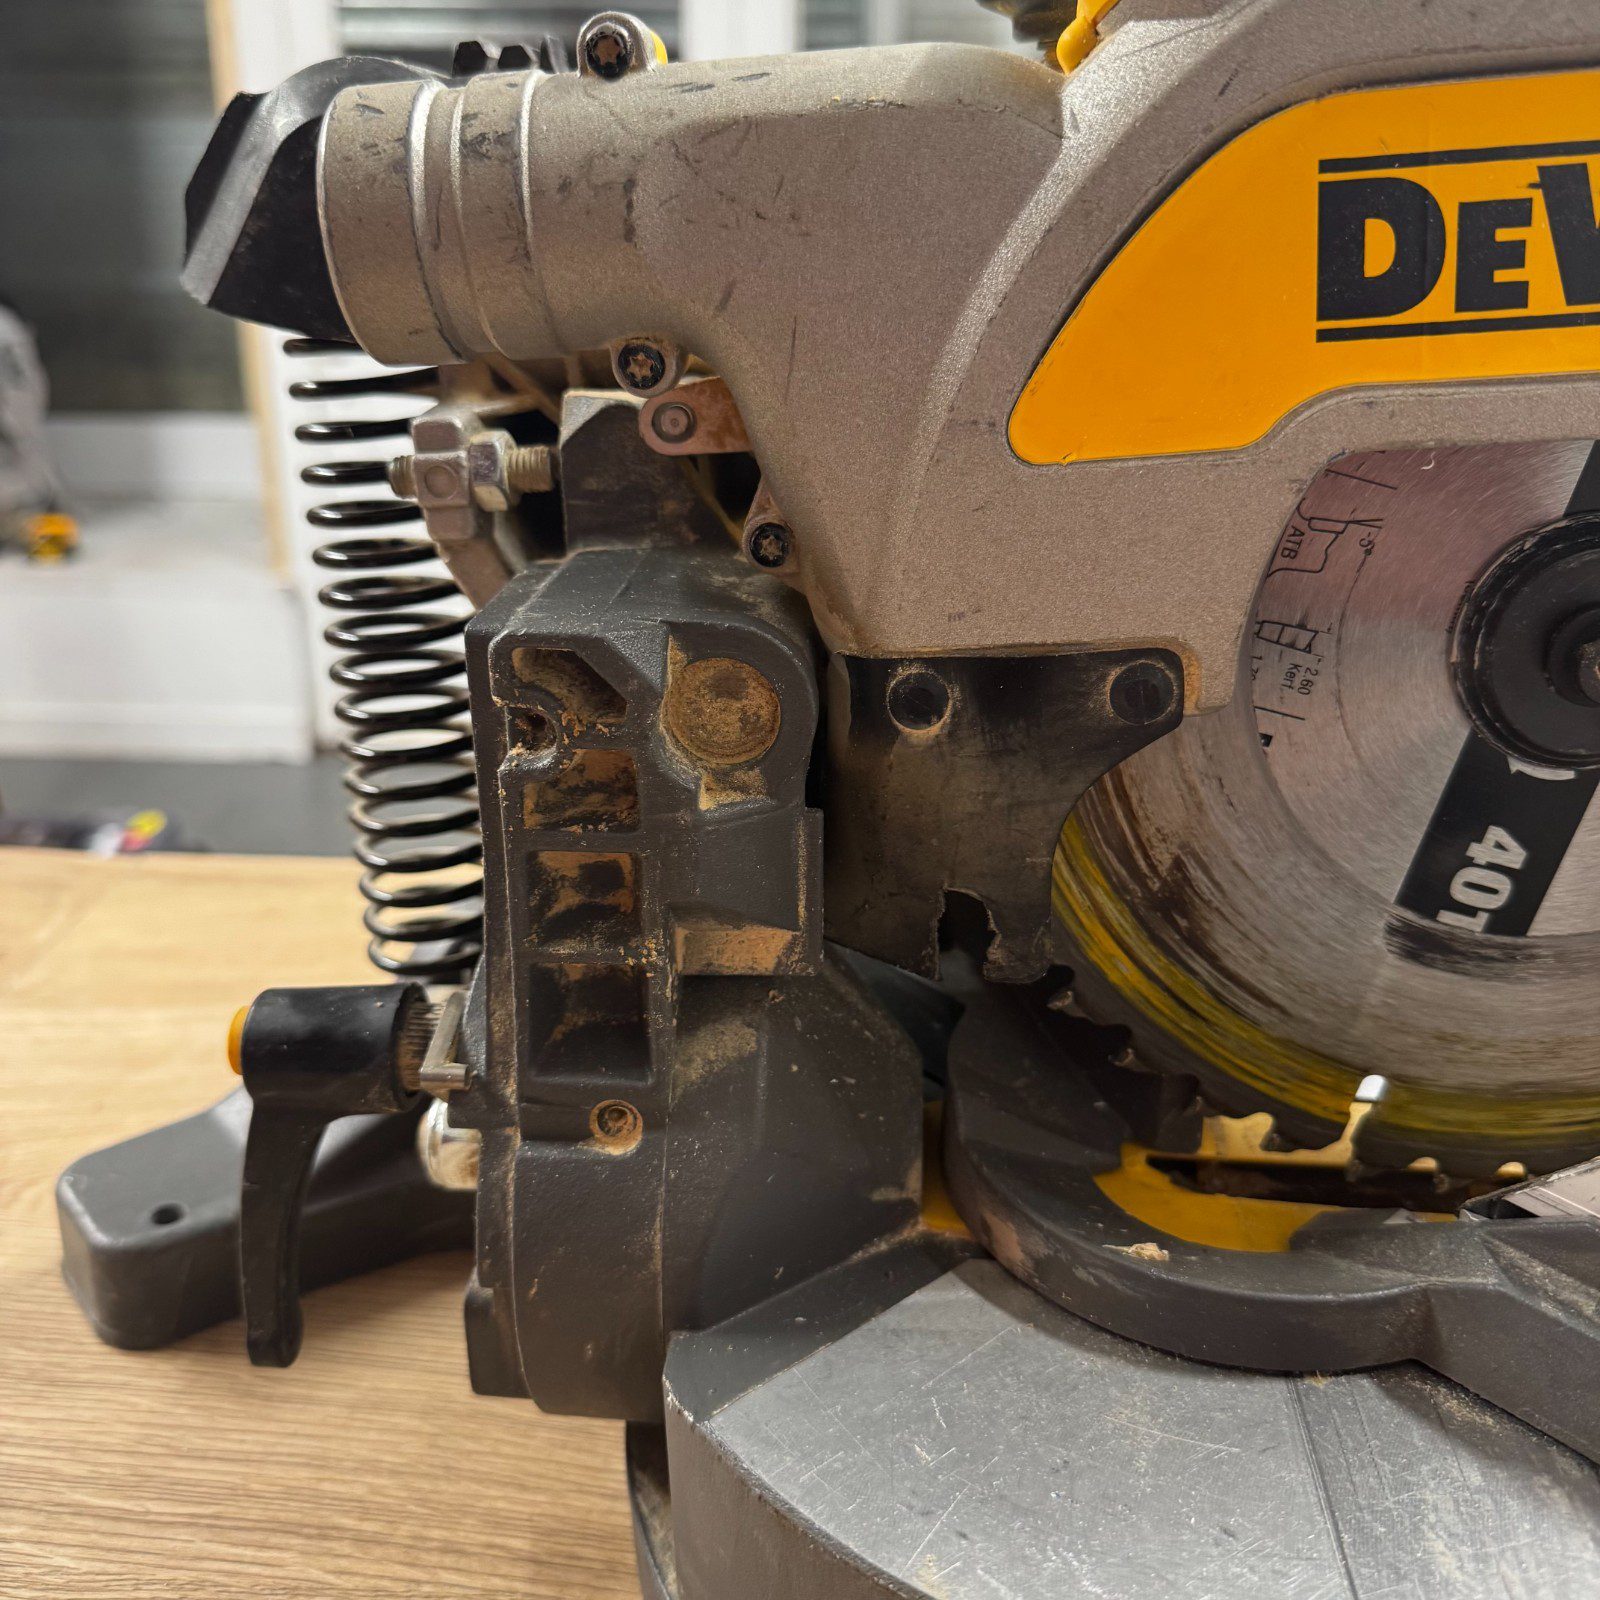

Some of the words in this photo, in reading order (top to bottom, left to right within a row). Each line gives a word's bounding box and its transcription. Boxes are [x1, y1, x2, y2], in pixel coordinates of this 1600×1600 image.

[1281, 525, 1305, 560] ATB
[1281, 662, 1303, 690] Kerf
[1297, 667, 1318, 696] 2.60
